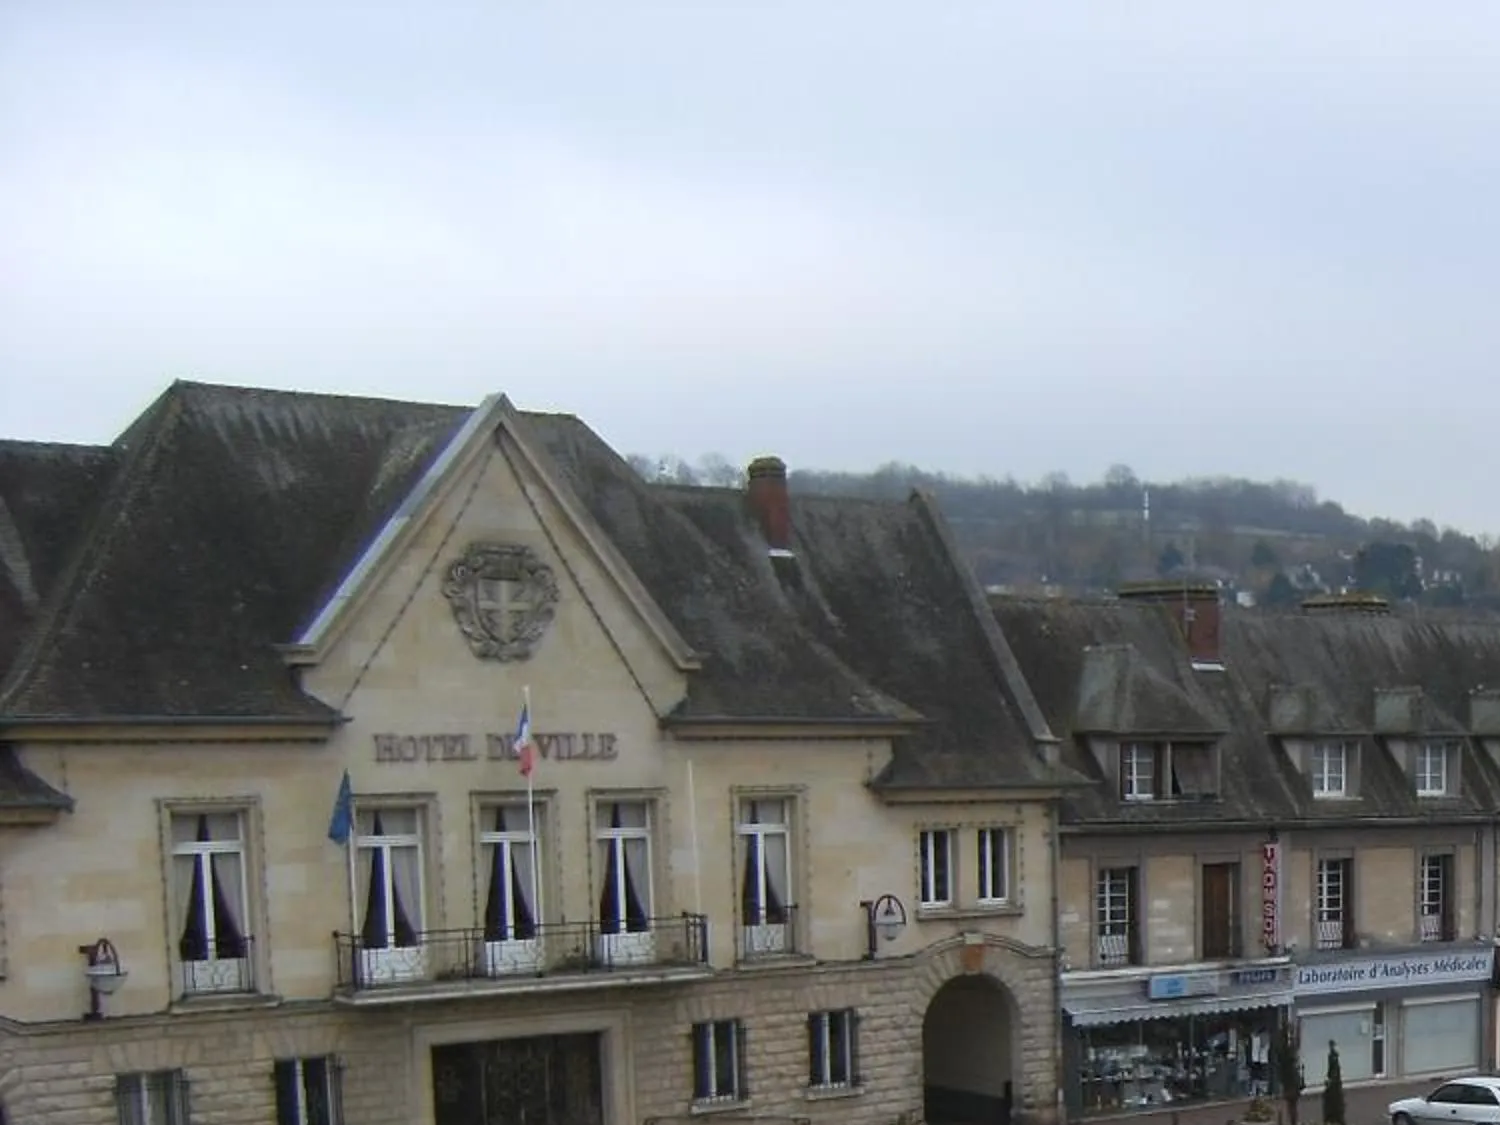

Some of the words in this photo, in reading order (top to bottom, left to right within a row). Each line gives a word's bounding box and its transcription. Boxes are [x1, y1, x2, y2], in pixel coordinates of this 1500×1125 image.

[530, 732, 618, 762] VILLE
[1299, 966, 1365, 985] Laboratoire
[1369, 960, 1430, 979] d'Analyses
[1432, 955, 1487, 973] Médicales
